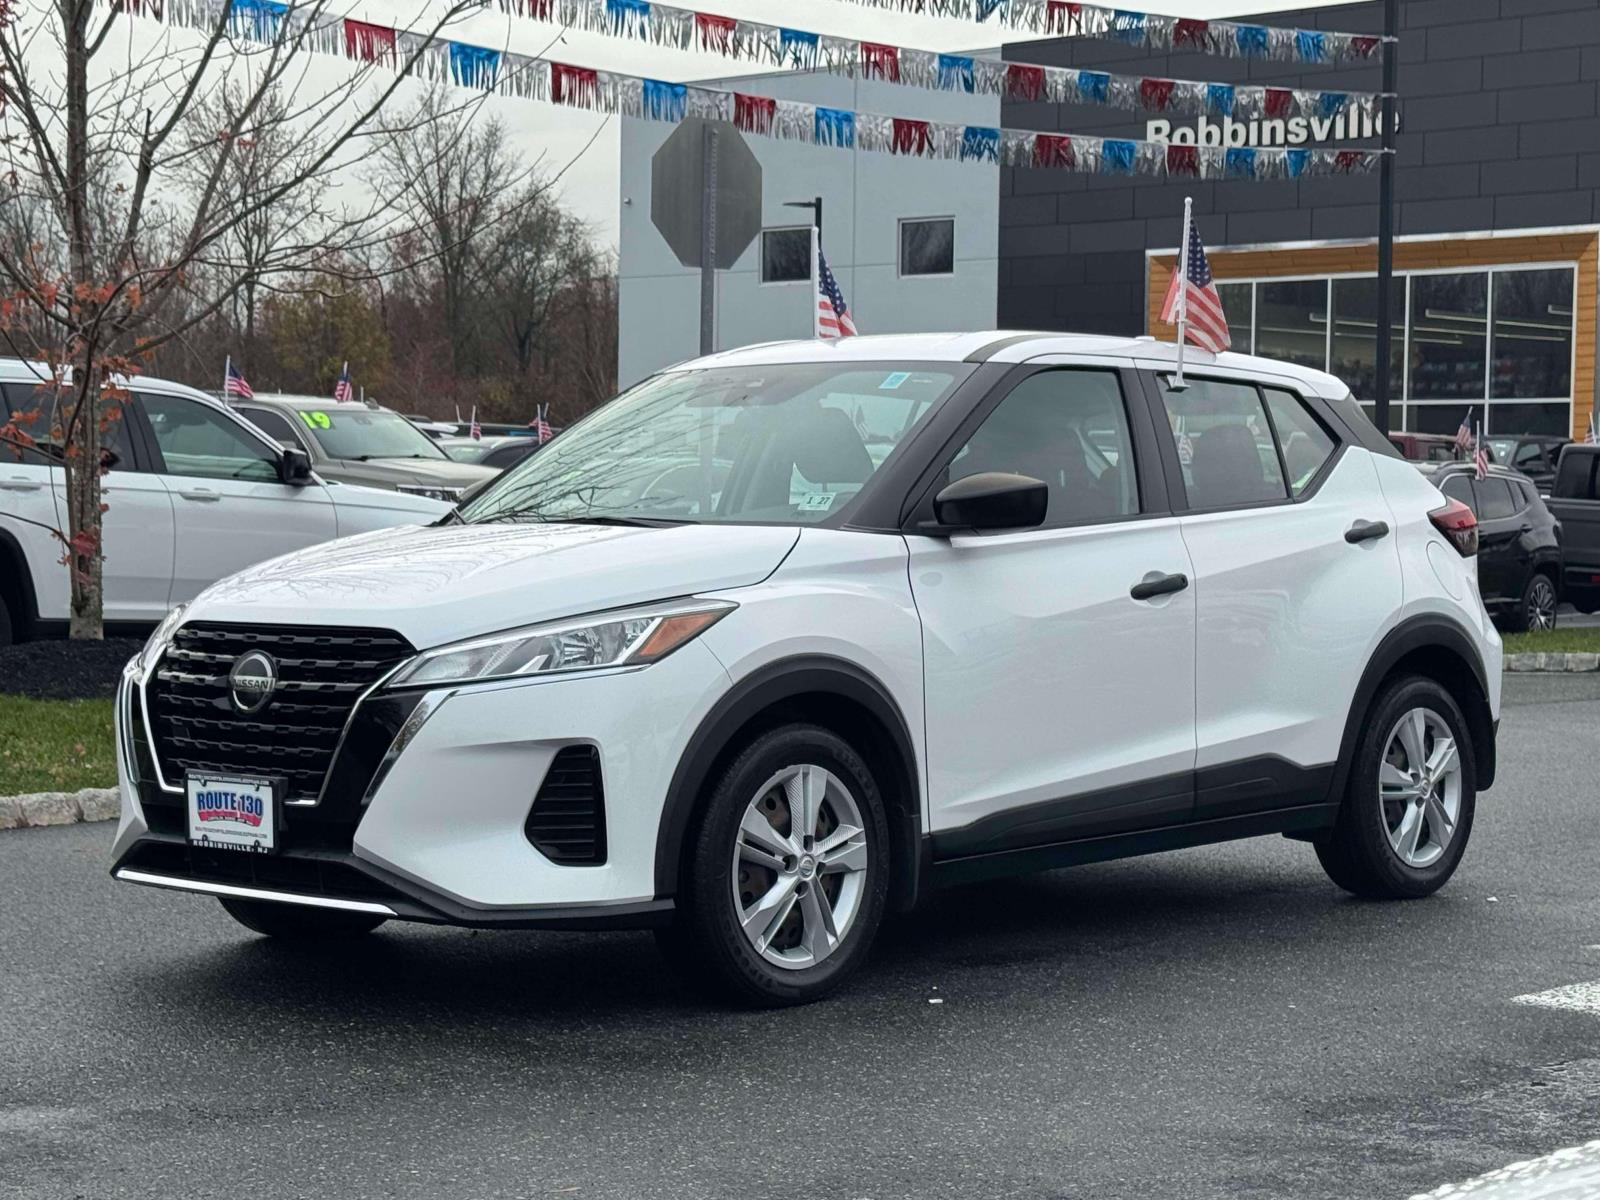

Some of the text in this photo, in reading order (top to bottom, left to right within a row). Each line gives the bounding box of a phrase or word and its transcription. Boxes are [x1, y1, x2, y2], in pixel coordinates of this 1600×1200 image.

[299, 411, 330, 429] 19
[817, 496, 830, 504] 27
[235, 679, 269, 689] NISSAN
[196, 791, 263, 816] ROUTE 130
